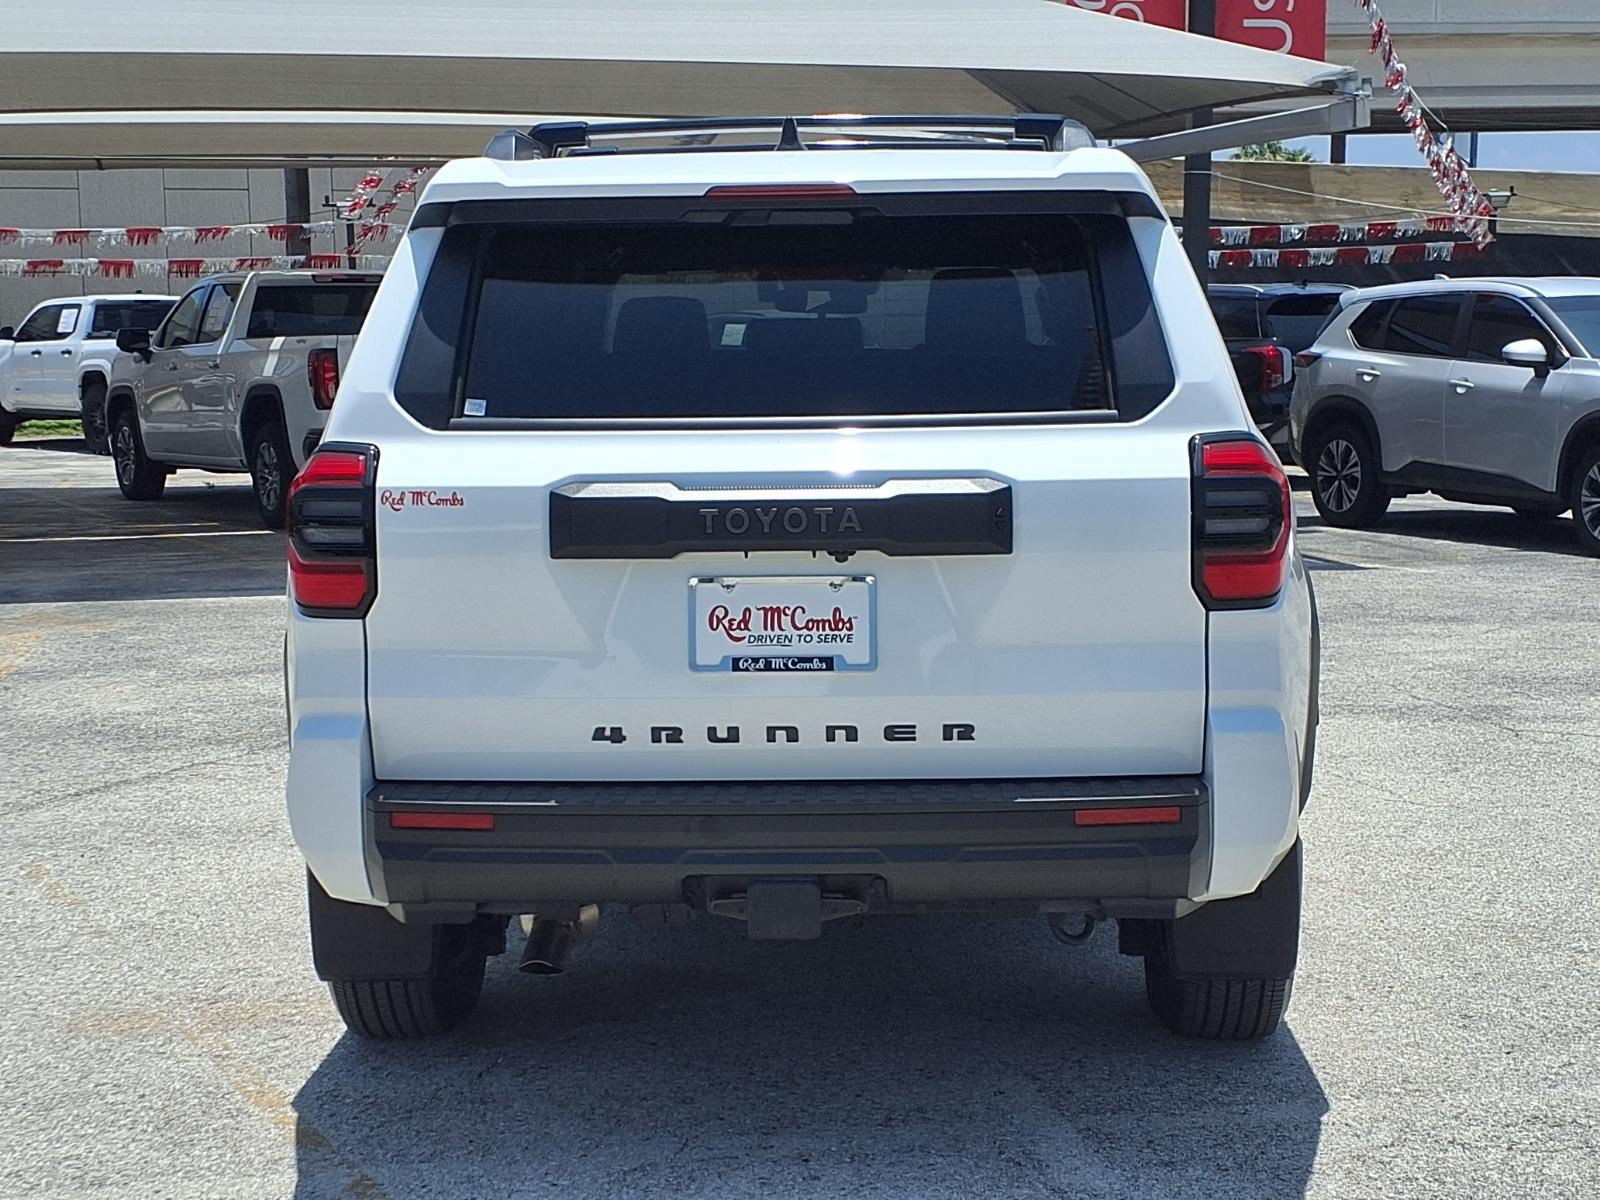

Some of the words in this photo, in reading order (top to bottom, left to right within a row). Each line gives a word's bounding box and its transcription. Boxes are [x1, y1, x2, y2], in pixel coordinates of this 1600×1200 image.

[381, 490, 405, 512] Red
[408, 491, 464, 506] McCombs
[699, 507, 863, 534] TOYOTA
[709, 604, 752, 642] Red
[755, 605, 854, 632] McCombs
[747, 633, 794, 646] DRIVEN
[796, 633, 813, 645] TO
[816, 633, 854, 644] SERVE
[738, 656, 766, 671] Red
[768, 656, 827, 670] McCombs
